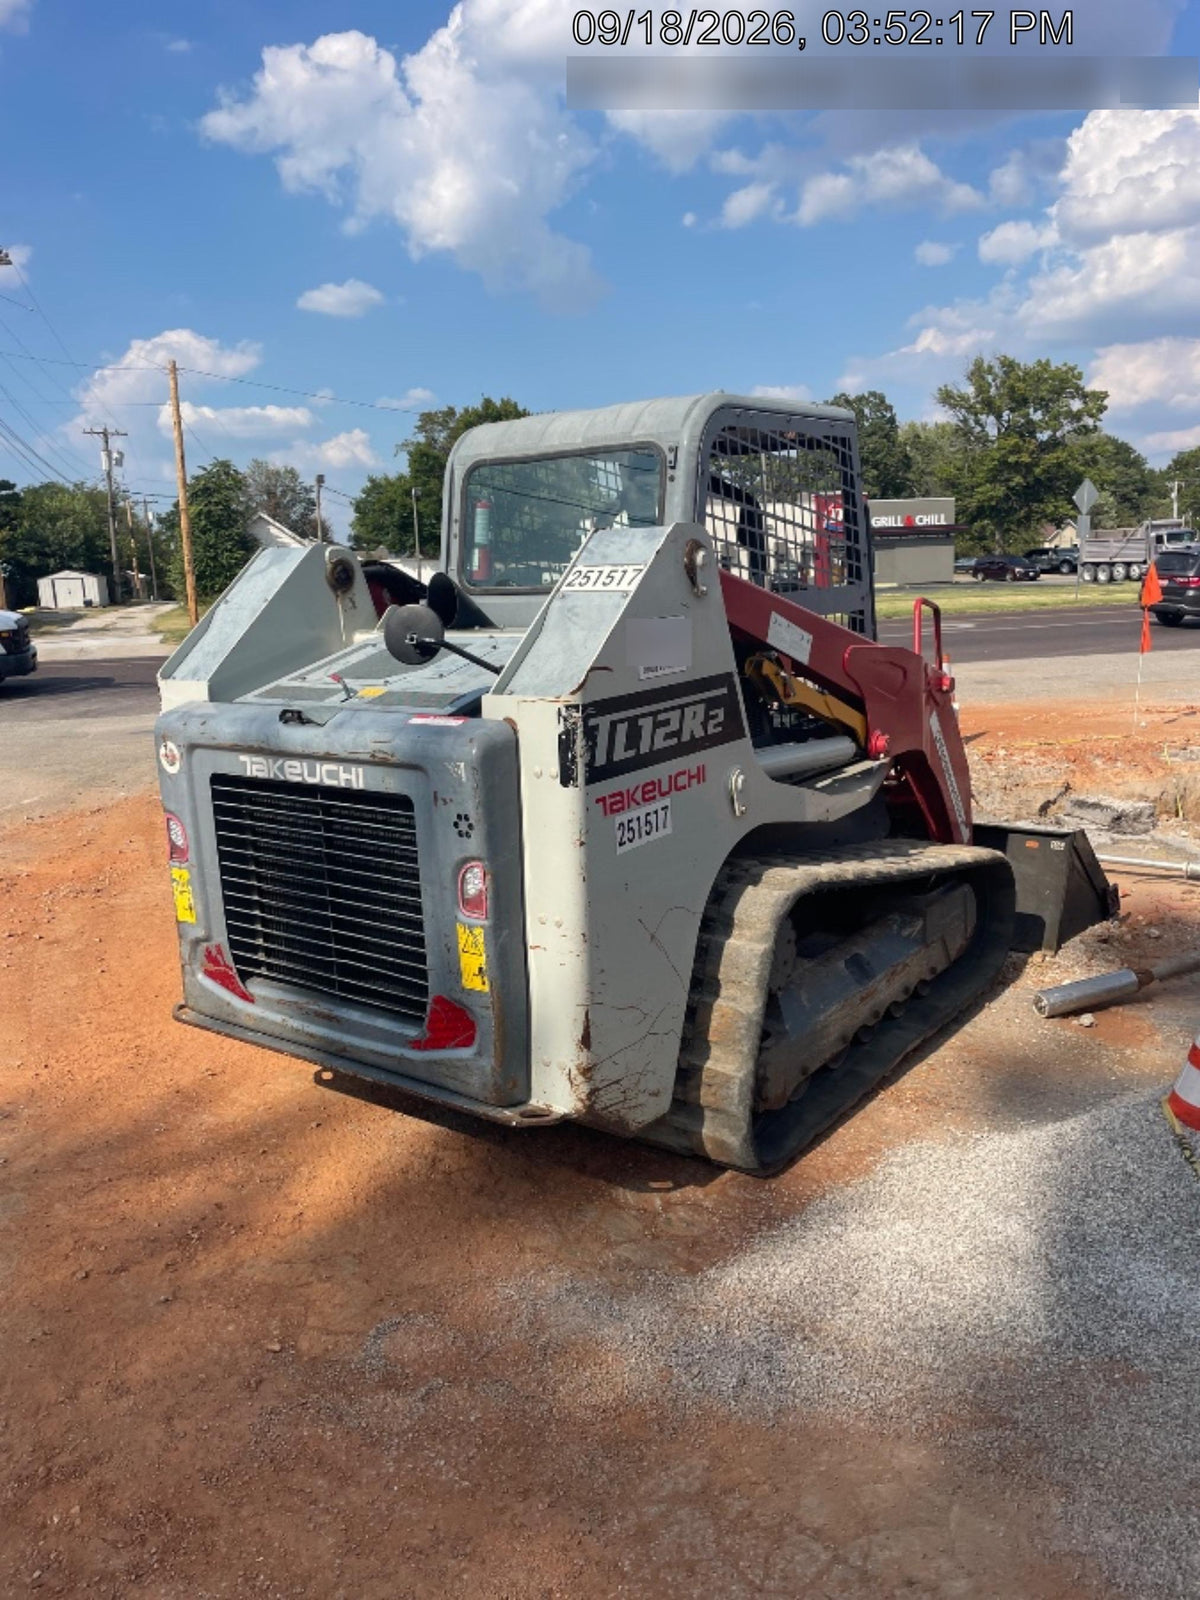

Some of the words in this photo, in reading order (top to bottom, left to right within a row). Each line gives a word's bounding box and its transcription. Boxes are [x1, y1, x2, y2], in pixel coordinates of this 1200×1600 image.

[871, 515, 903, 528] GRILL
[915, 513, 947, 525] CHILL
[566, 568, 643, 588] 251517
[617, 805, 669, 847] 251517
